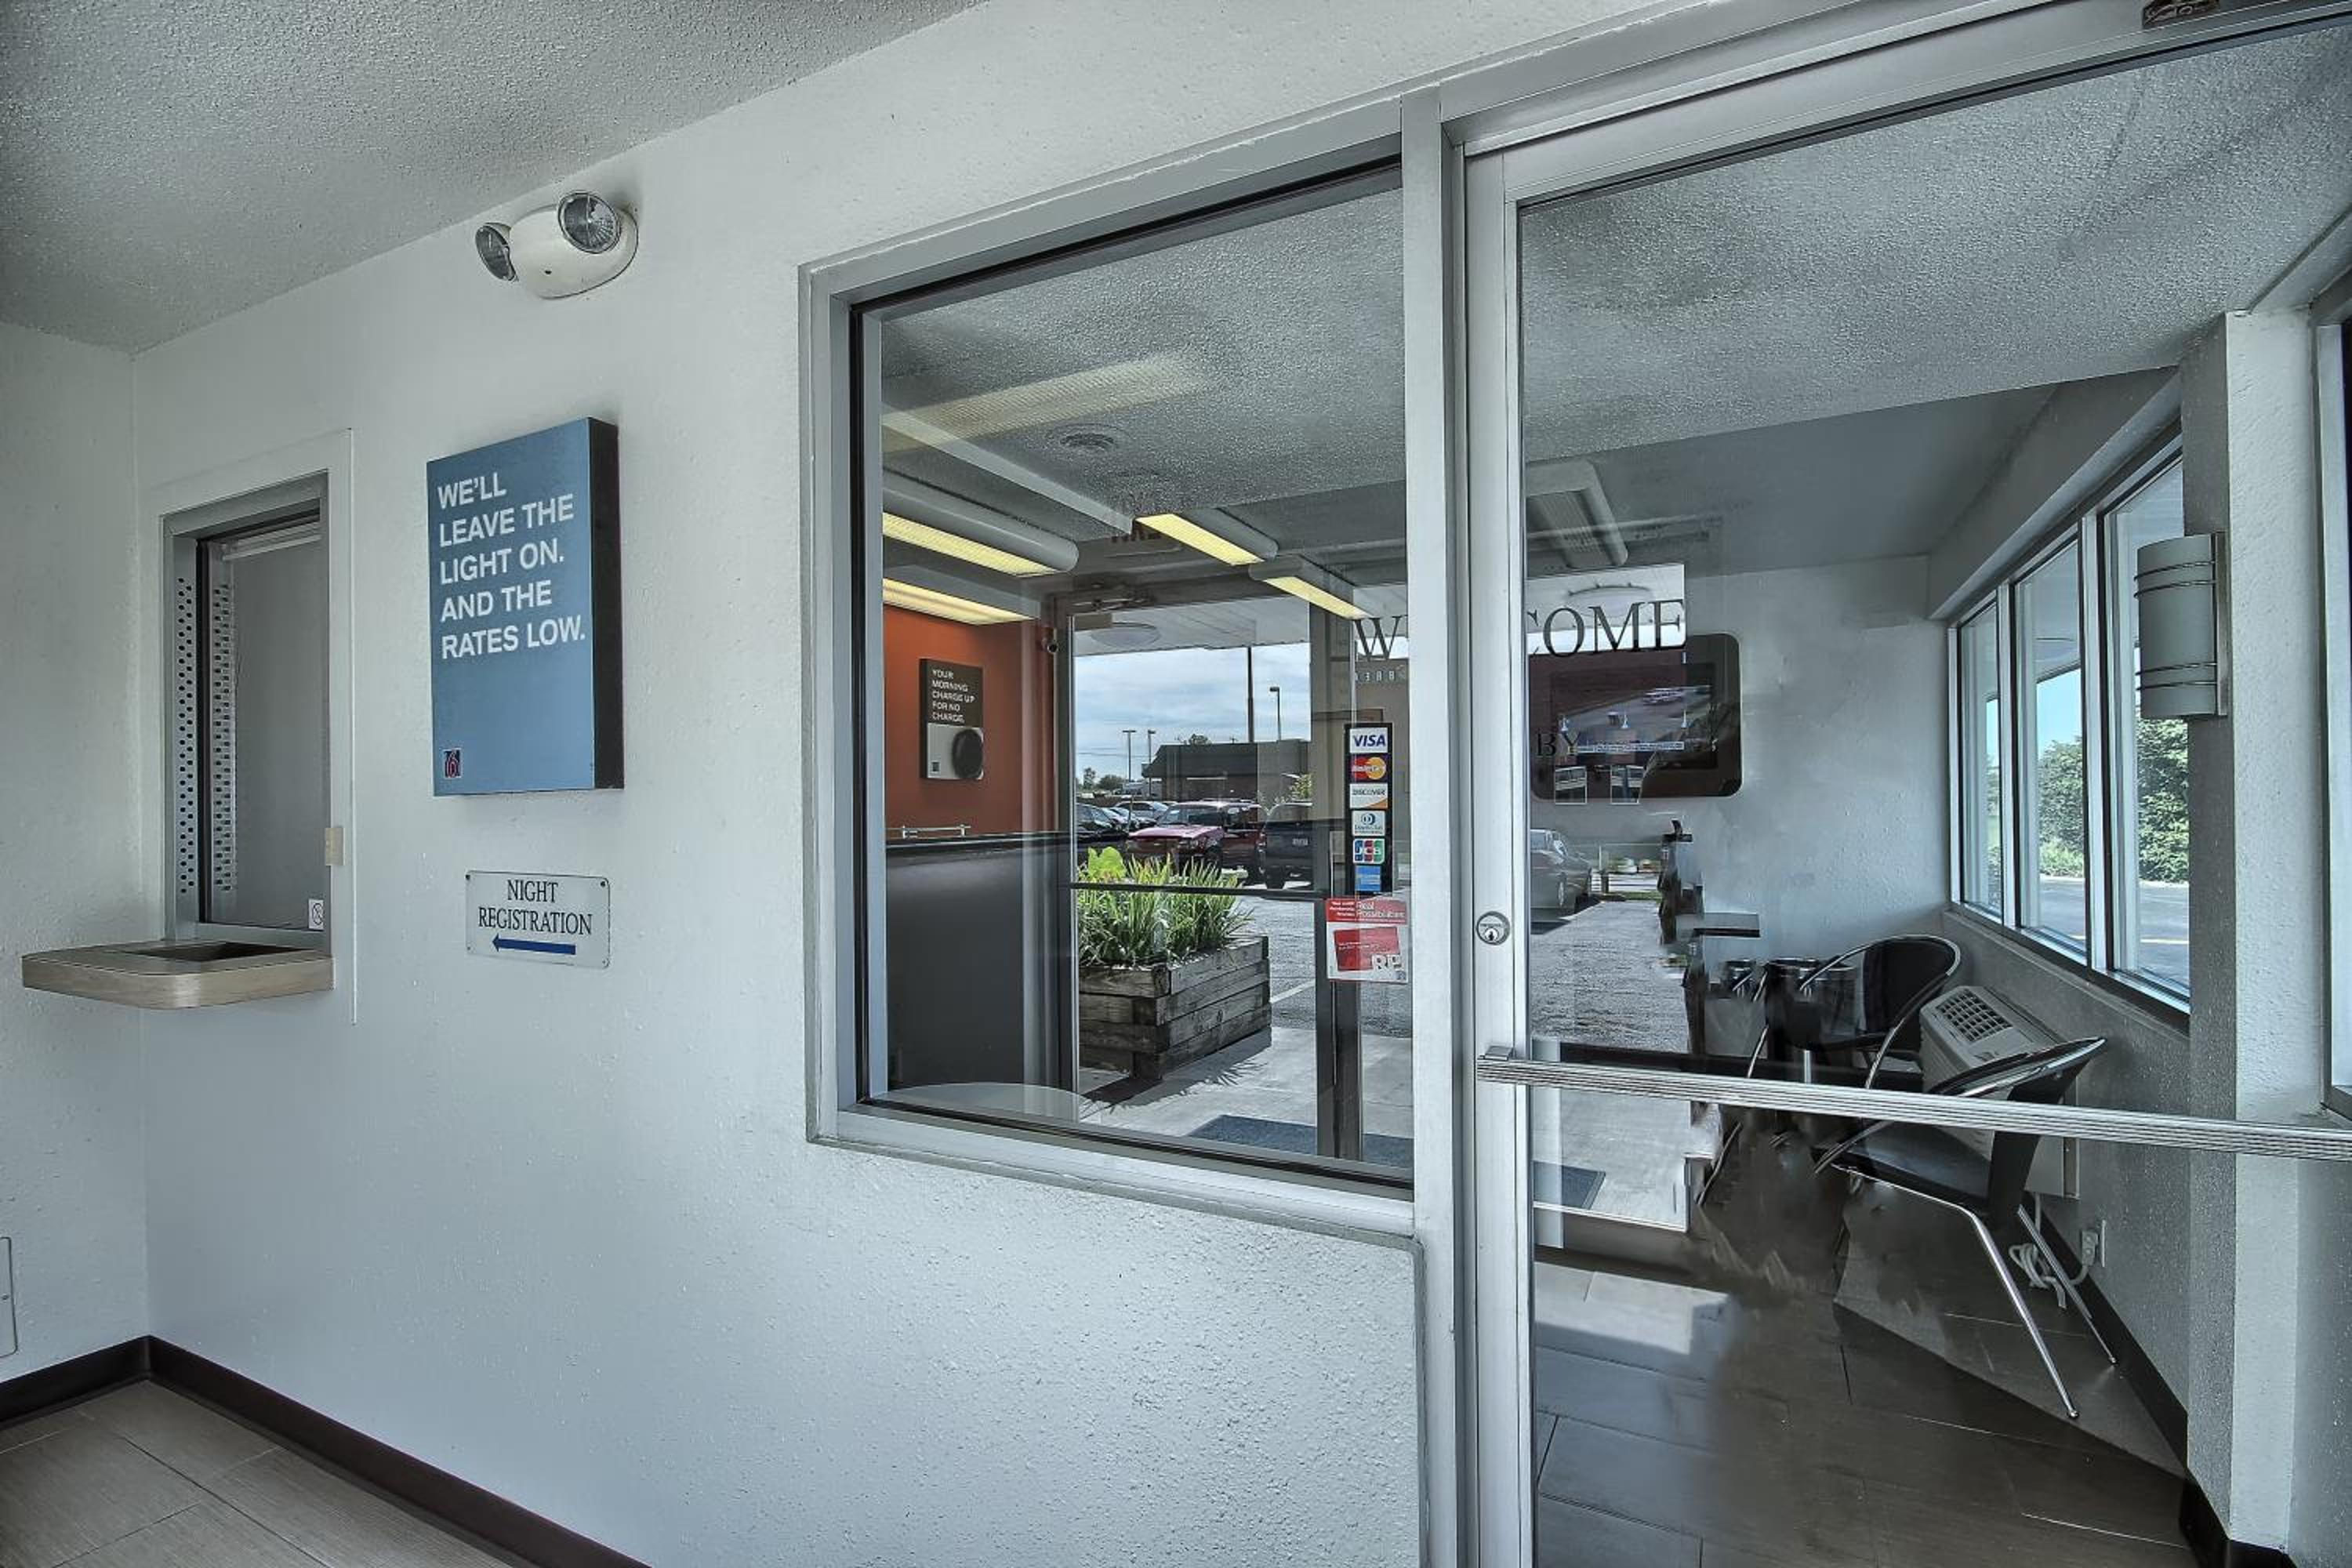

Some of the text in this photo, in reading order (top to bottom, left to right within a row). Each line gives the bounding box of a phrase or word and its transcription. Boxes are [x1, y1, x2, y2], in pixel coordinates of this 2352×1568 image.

[440, 495, 574, 547] LEAVE THE
[441, 538, 564, 585] LIGHT ON.
[441, 580, 552, 622] AND THE
[442, 615, 586, 659] RATES LOW.
[931, 680, 968, 692] MORNING
[932, 669, 954, 679] YOUR
[932, 691, 975, 703] CHARGE UP
[932, 701, 960, 712] FOR NO
[1353, 734, 1386, 747] VISA
[507, 879, 558, 903] NIGHT
[478, 906, 593, 935] REGISTRATION
